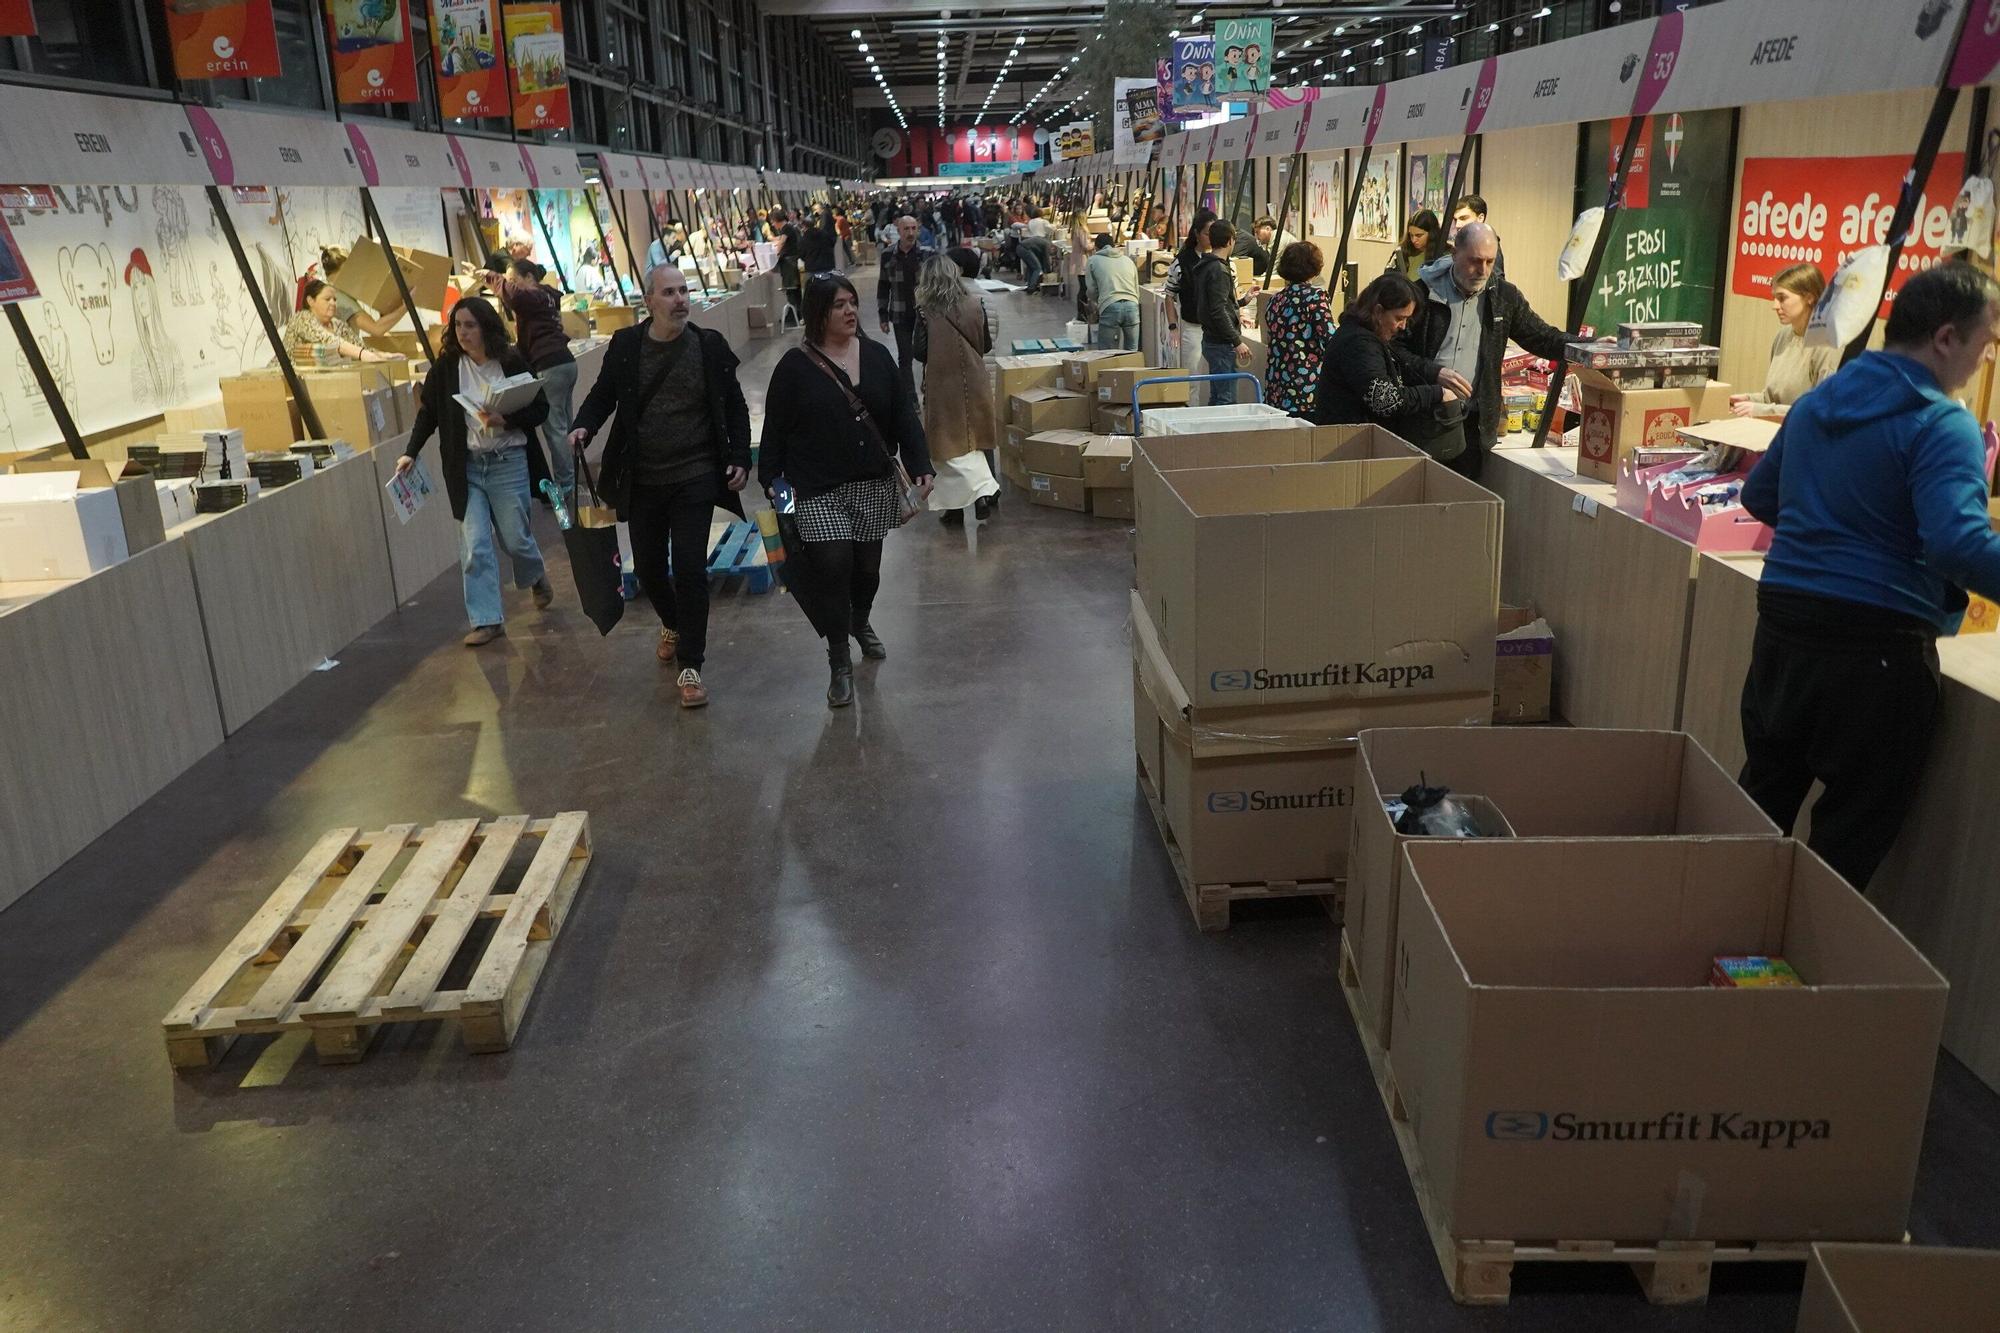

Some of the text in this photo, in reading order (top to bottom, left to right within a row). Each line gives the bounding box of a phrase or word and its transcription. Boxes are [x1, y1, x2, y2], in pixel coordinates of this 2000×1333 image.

[1750, 35, 1798, 66] AFEDE
[206, 59, 248, 72] erein
[360, 87, 394, 97] erein
[1533, 77, 1560, 99] AFEDE
[461, 105, 490, 113] erein
[1133, 107, 1158, 120] NEGRA
[1134, 99, 1155, 111] ALMA
[1407, 102, 1426, 119] EROSKI
[530, 117, 555, 125] erein
[74, 132, 112, 153] EREIN
[279, 147, 302, 163] EREIN
[1743, 190, 1828, 242] afede
[1625, 228, 1666, 262] EROSI
[1624, 294, 1660, 324] TOKI
[1252, 663, 1434, 690] Smurfit Kappa
[1249, 787, 1346, 811] Smurfit
[1552, 1111, 1832, 1149] Smurfit Kappa
